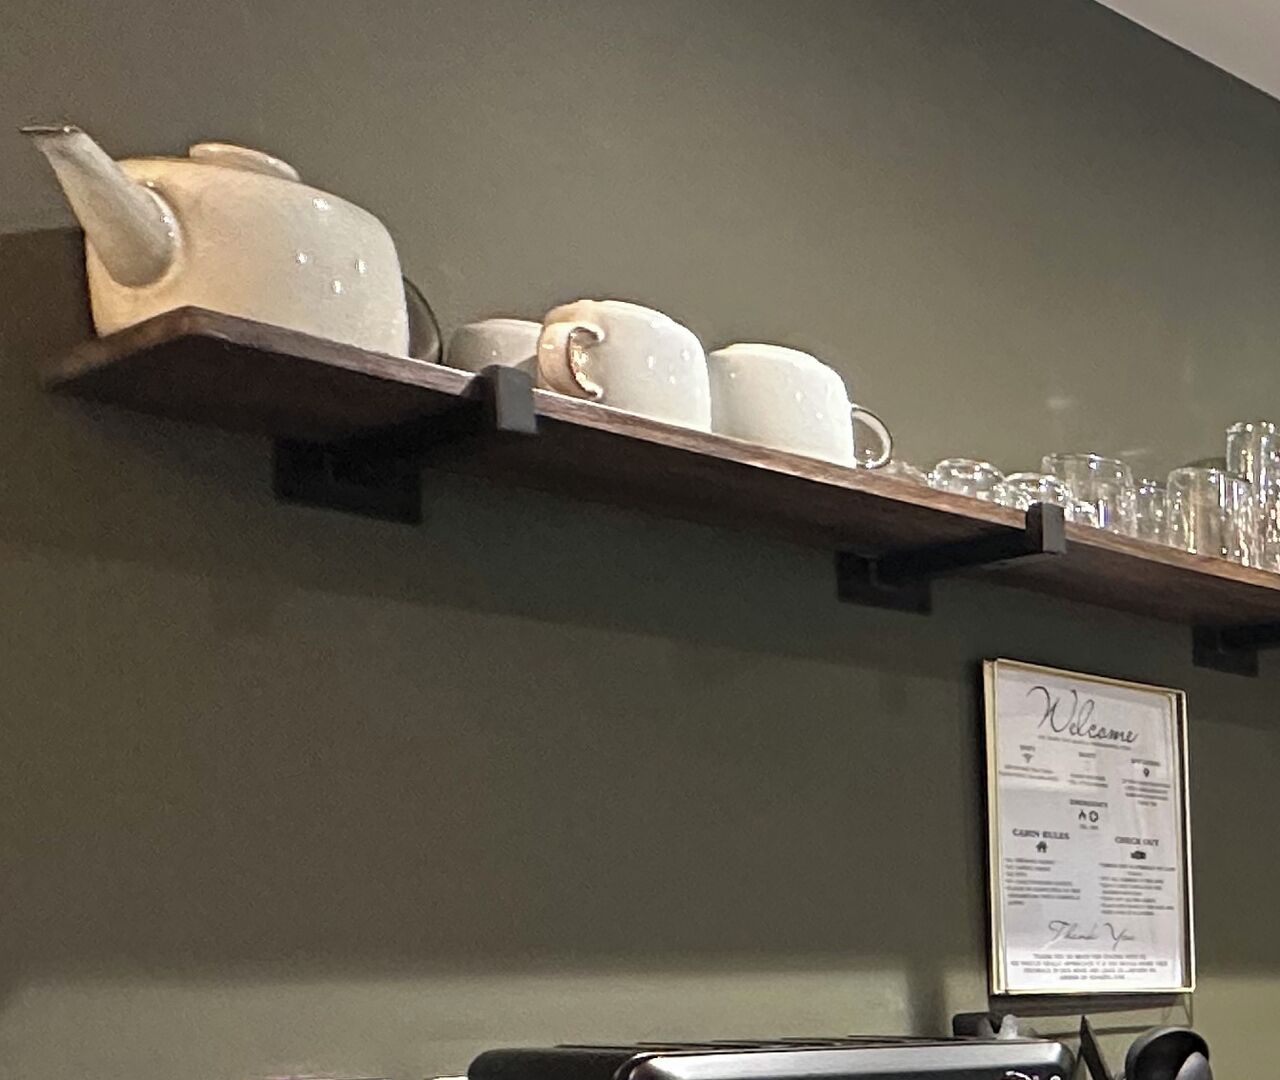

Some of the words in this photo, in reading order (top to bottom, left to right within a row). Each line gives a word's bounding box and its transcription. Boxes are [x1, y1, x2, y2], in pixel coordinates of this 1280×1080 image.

[1025, 685, 1139, 743] Welcome
[1012, 828, 1040, 839] CABIN
[1042, 831, 1071, 841] RULES
[1114, 836, 1141, 847] CHECK
[1143, 838, 1160, 847] OUT
[1048, 919, 1100, 942] Thank
[1104, 922, 1136, 951] You
